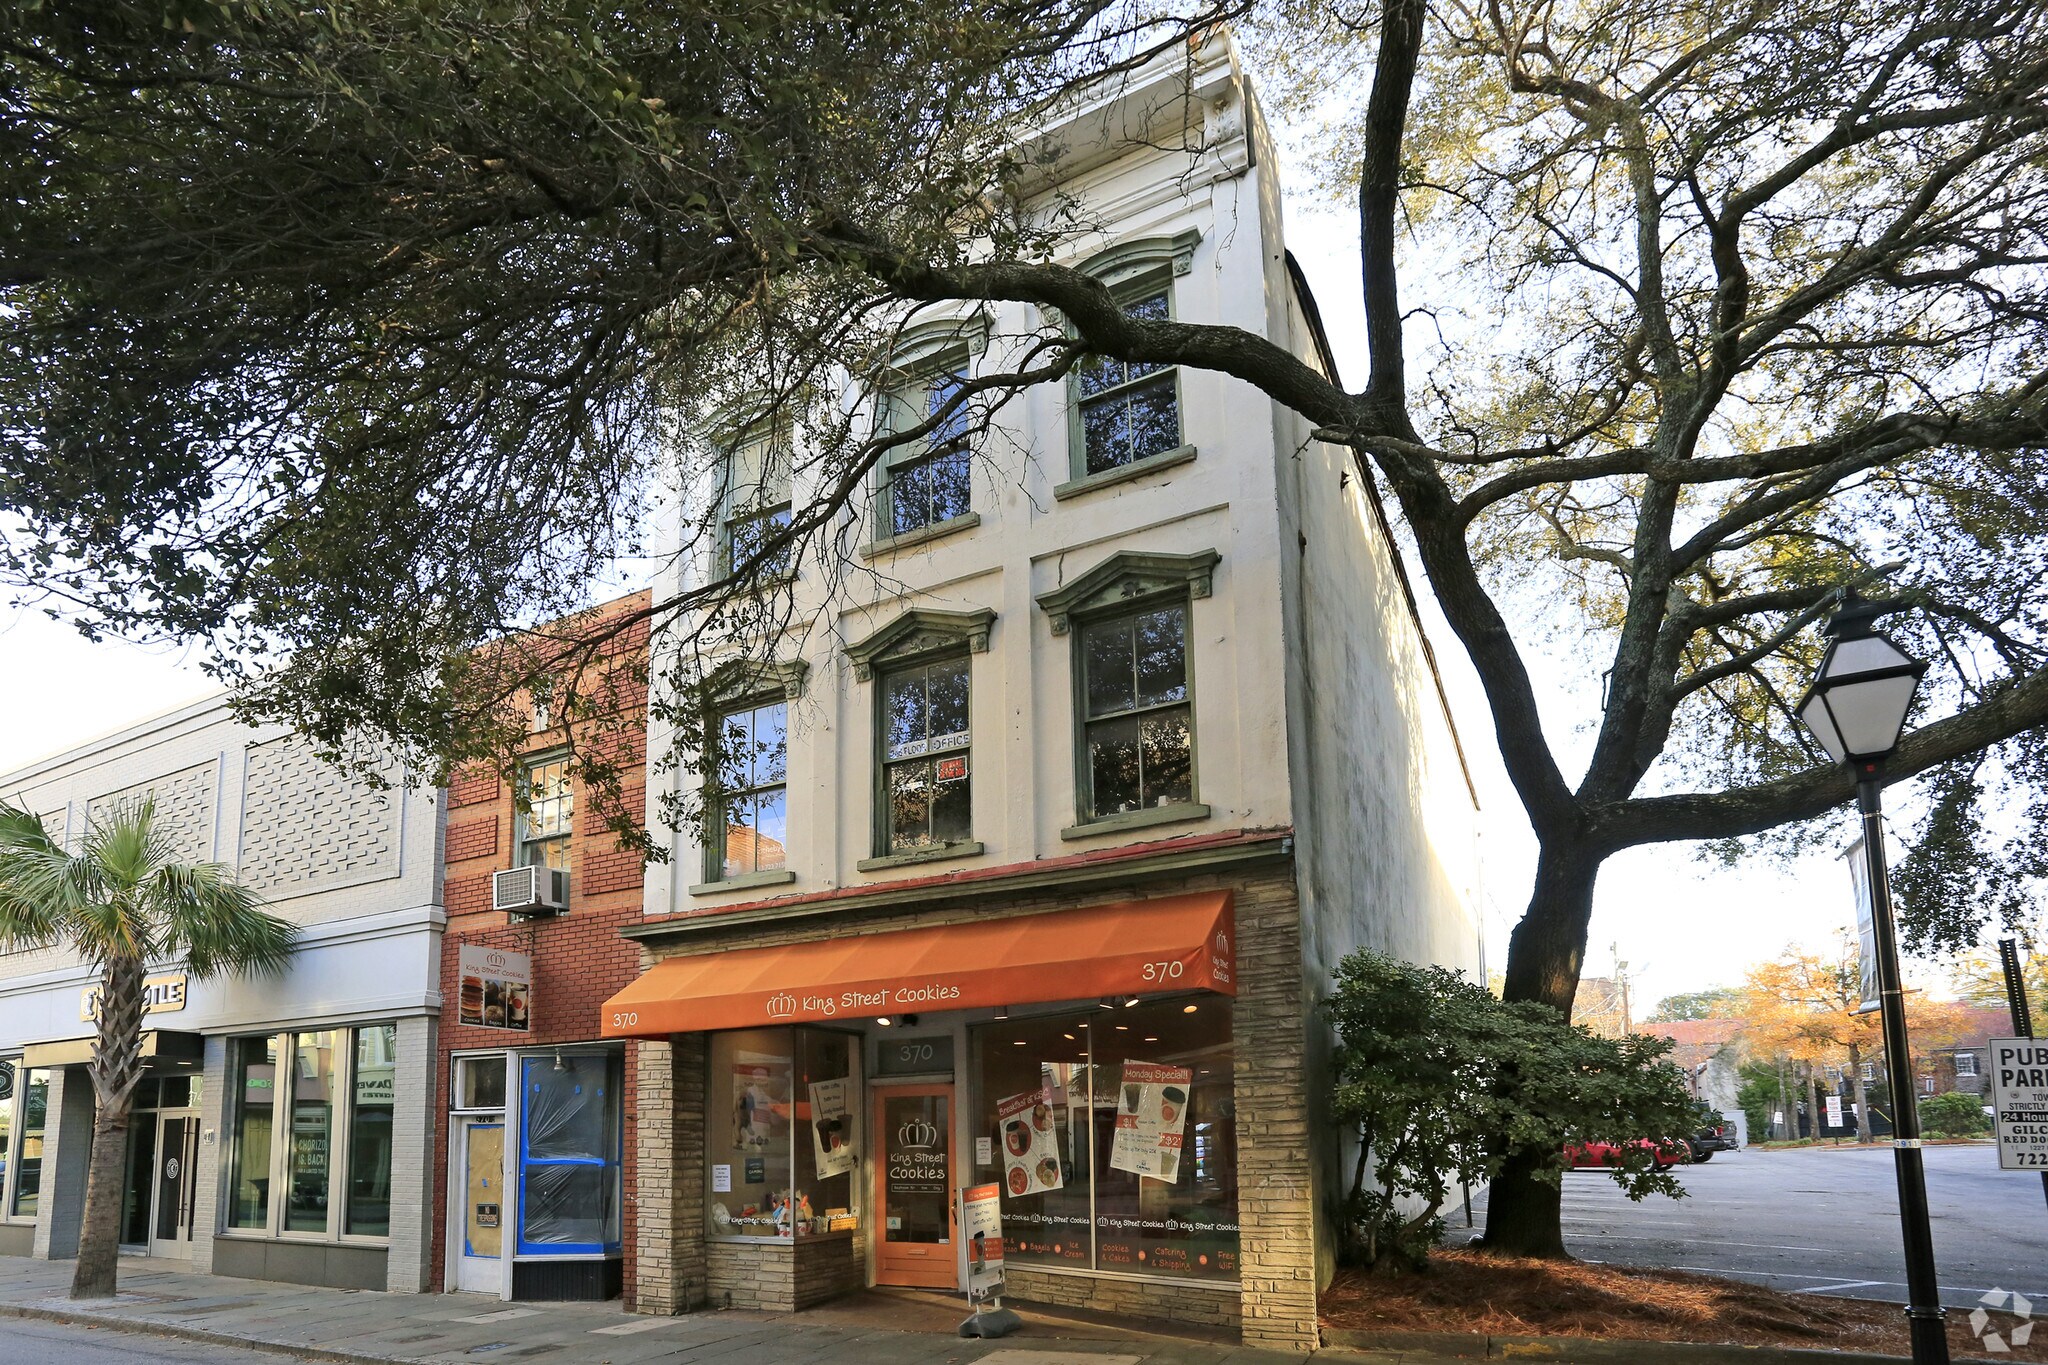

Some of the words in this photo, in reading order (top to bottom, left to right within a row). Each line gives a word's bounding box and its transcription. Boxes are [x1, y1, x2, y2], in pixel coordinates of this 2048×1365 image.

[904, 743, 927, 756] FLOOR
[933, 734, 969, 750] OFFICE
[466, 964, 480, 974] King
[481, 967, 500, 975] Street
[501, 970, 525, 979] Cookies
[1142, 960, 1183, 983] 370
[803, 995, 836, 1016] King
[841, 988, 890, 1008] Street
[895, 984, 960, 1003] Cookies
[613, 1012, 638, 1029] 370
[900, 1044, 934, 1064] 370
[1125, 1069, 1153, 1082] Monday
[2001, 1069, 2048, 1088] PAR
[999, 1098, 1026, 1116] Breakfast
[2009, 1103, 2046, 1111] STRICTLY
[2003, 1112, 2018, 1122] 24
[298, 1139, 326, 1151] CHORIZO
[2004, 1135, 2027, 1144] RED
[2030, 1135, 2048, 1144] DO
[307, 1153, 325, 1166] BACK
[890, 1153, 912, 1166] King
[914, 1152, 946, 1164] Street
[890, 1166, 946, 1180] Cookies
[1042, 1215, 1053, 1225] King
[1069, 1216, 1090, 1225] Cookies
[1110, 1218, 1122, 1228] King
[1123, 1218, 1140, 1227] Street
[1141, 1220, 1164, 1229] Cookies
[1180, 1221, 1194, 1232] King
[1195, 1222, 1215, 1231] Street
[1030, 1242, 1051, 1254] Bagels
[1069, 1240, 1079, 1249] Ice
[1102, 1244, 1130, 1253] Cookies
[1064, 1250, 1085, 1259] Cream
[1108, 1254, 1130, 1263] Cakes
[1155, 1247, 1187, 1260] Catering
[1218, 1251, 1236, 1260] Free
[1159, 1259, 1192, 1272] Shipping
[1218, 1262, 1235, 1270] WiFi
